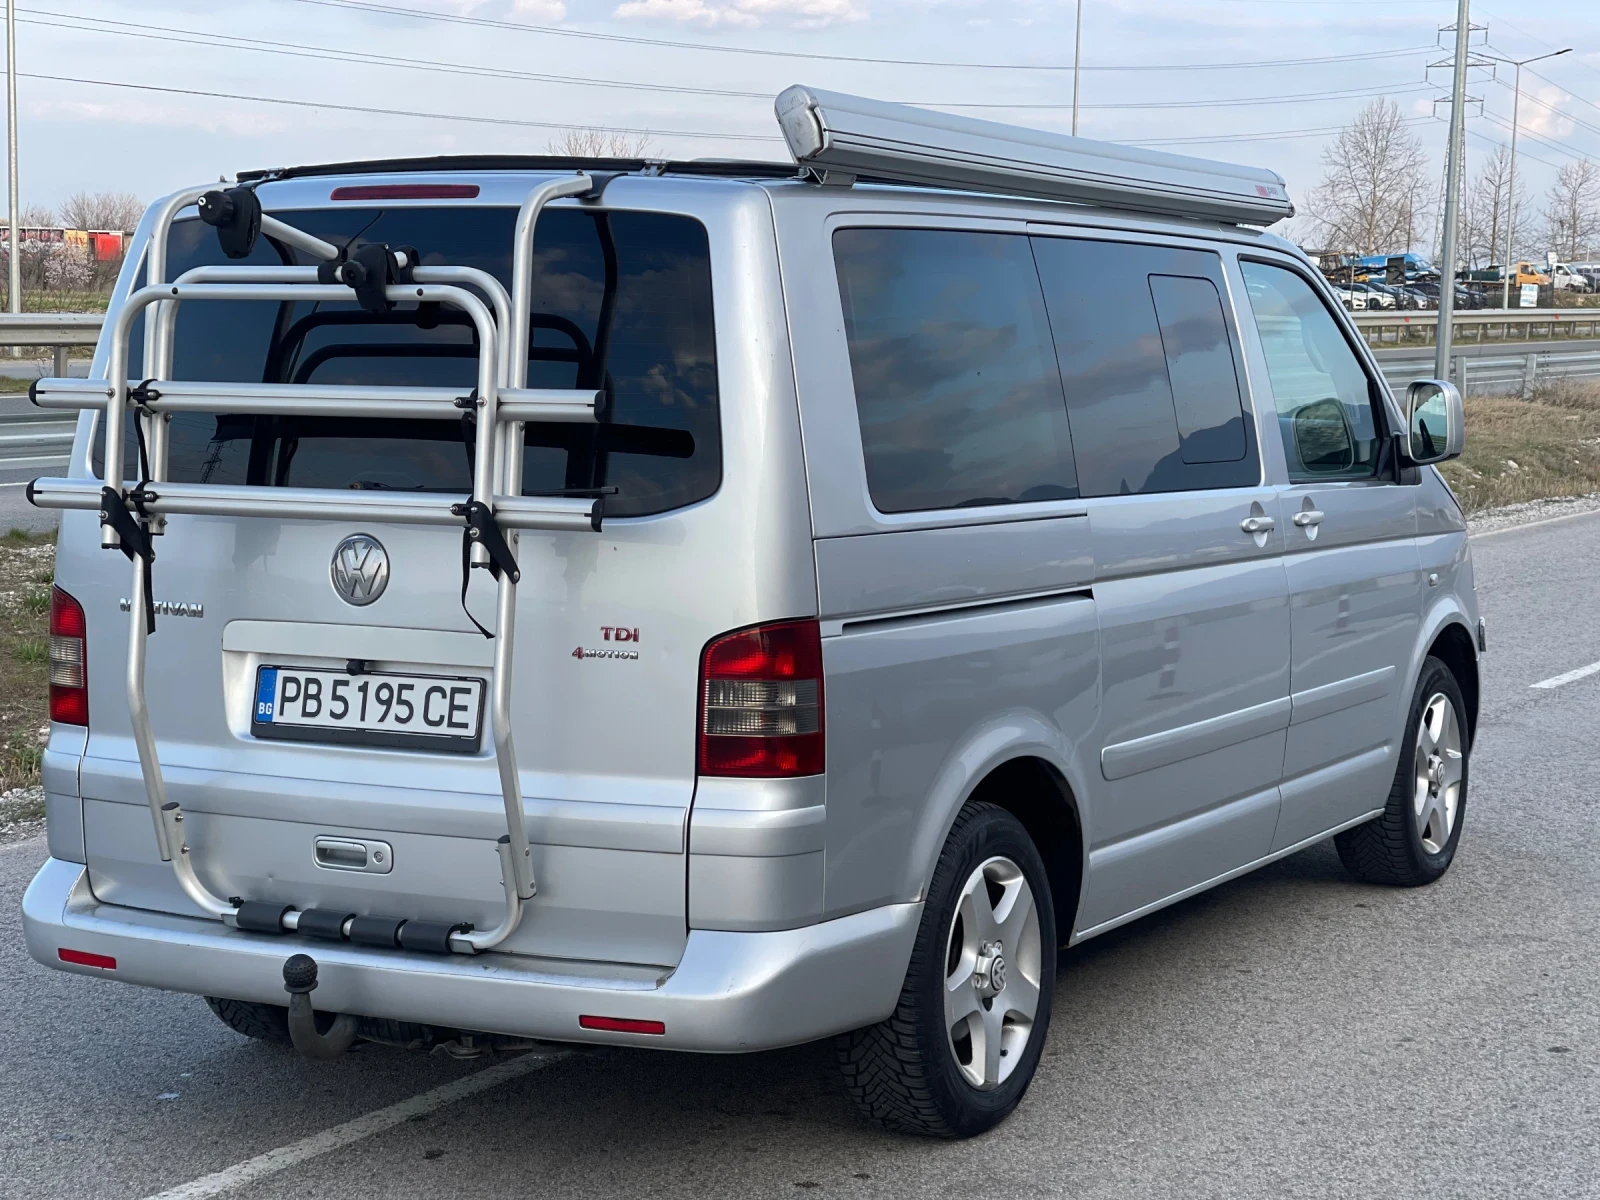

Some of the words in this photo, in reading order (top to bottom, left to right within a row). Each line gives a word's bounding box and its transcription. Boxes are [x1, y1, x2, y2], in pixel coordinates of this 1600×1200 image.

[119, 597, 204, 618] MTIVAN
[600, 626, 640, 643] TDI
[258, 701, 273, 715] BG
